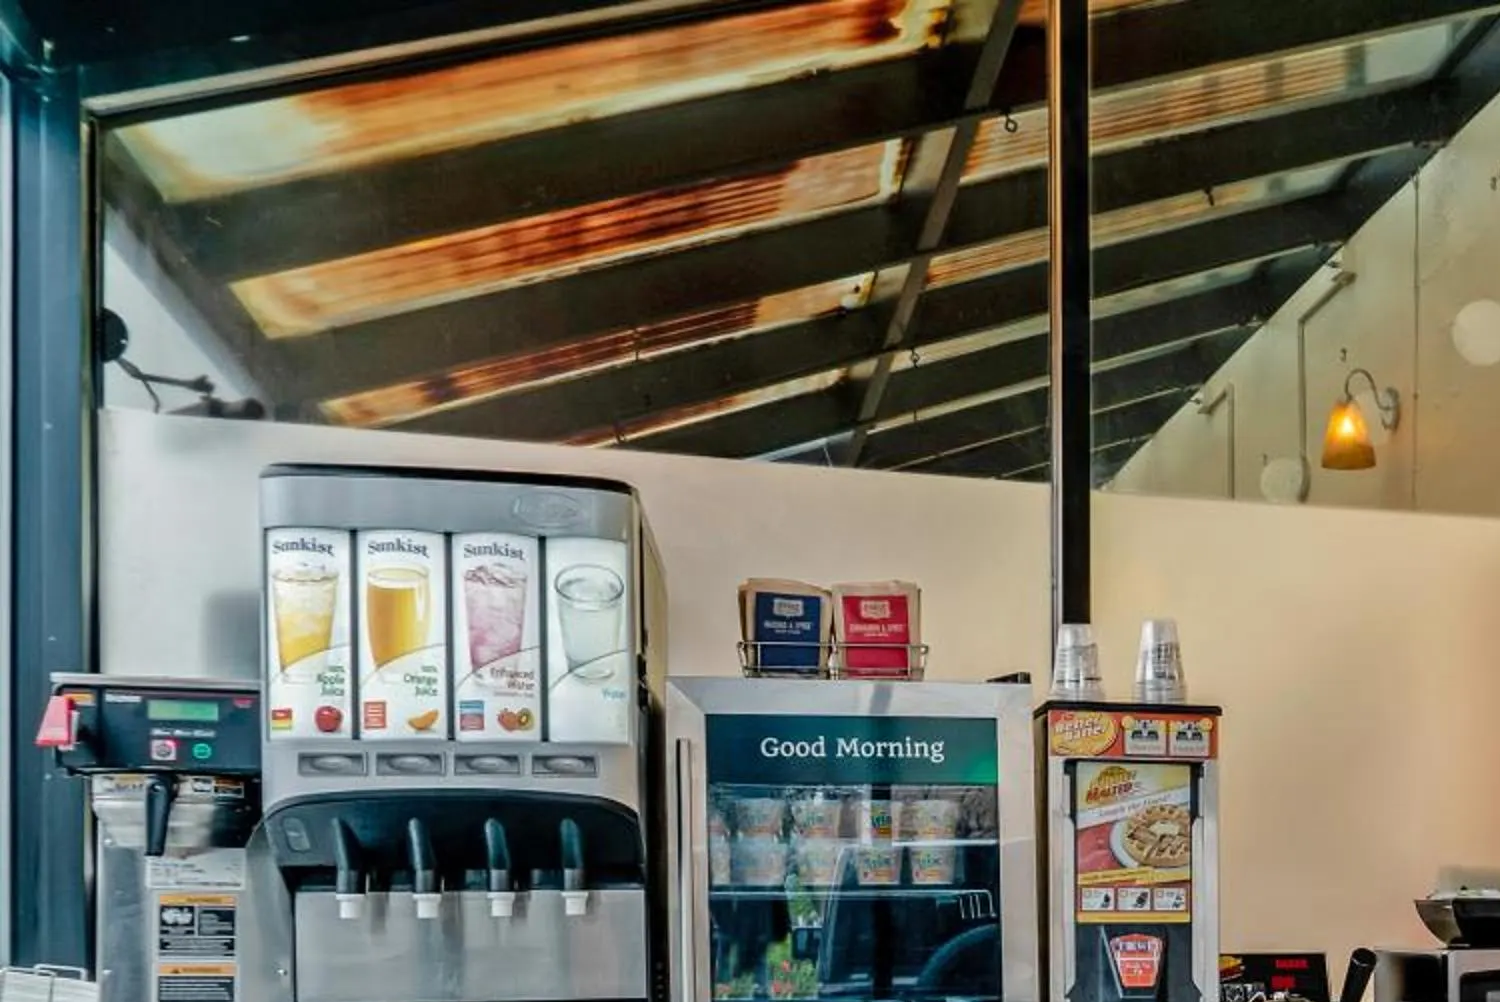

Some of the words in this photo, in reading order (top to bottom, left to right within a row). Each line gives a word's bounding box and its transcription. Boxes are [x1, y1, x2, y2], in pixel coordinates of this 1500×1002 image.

[272, 537, 335, 557] Sunkist
[367, 537, 430, 558] Sunkist
[463, 543, 526, 561] Sunkist
[403, 673, 438, 686] Orange
[760, 736, 827, 758] Good
[836, 736, 945, 763] Morning
